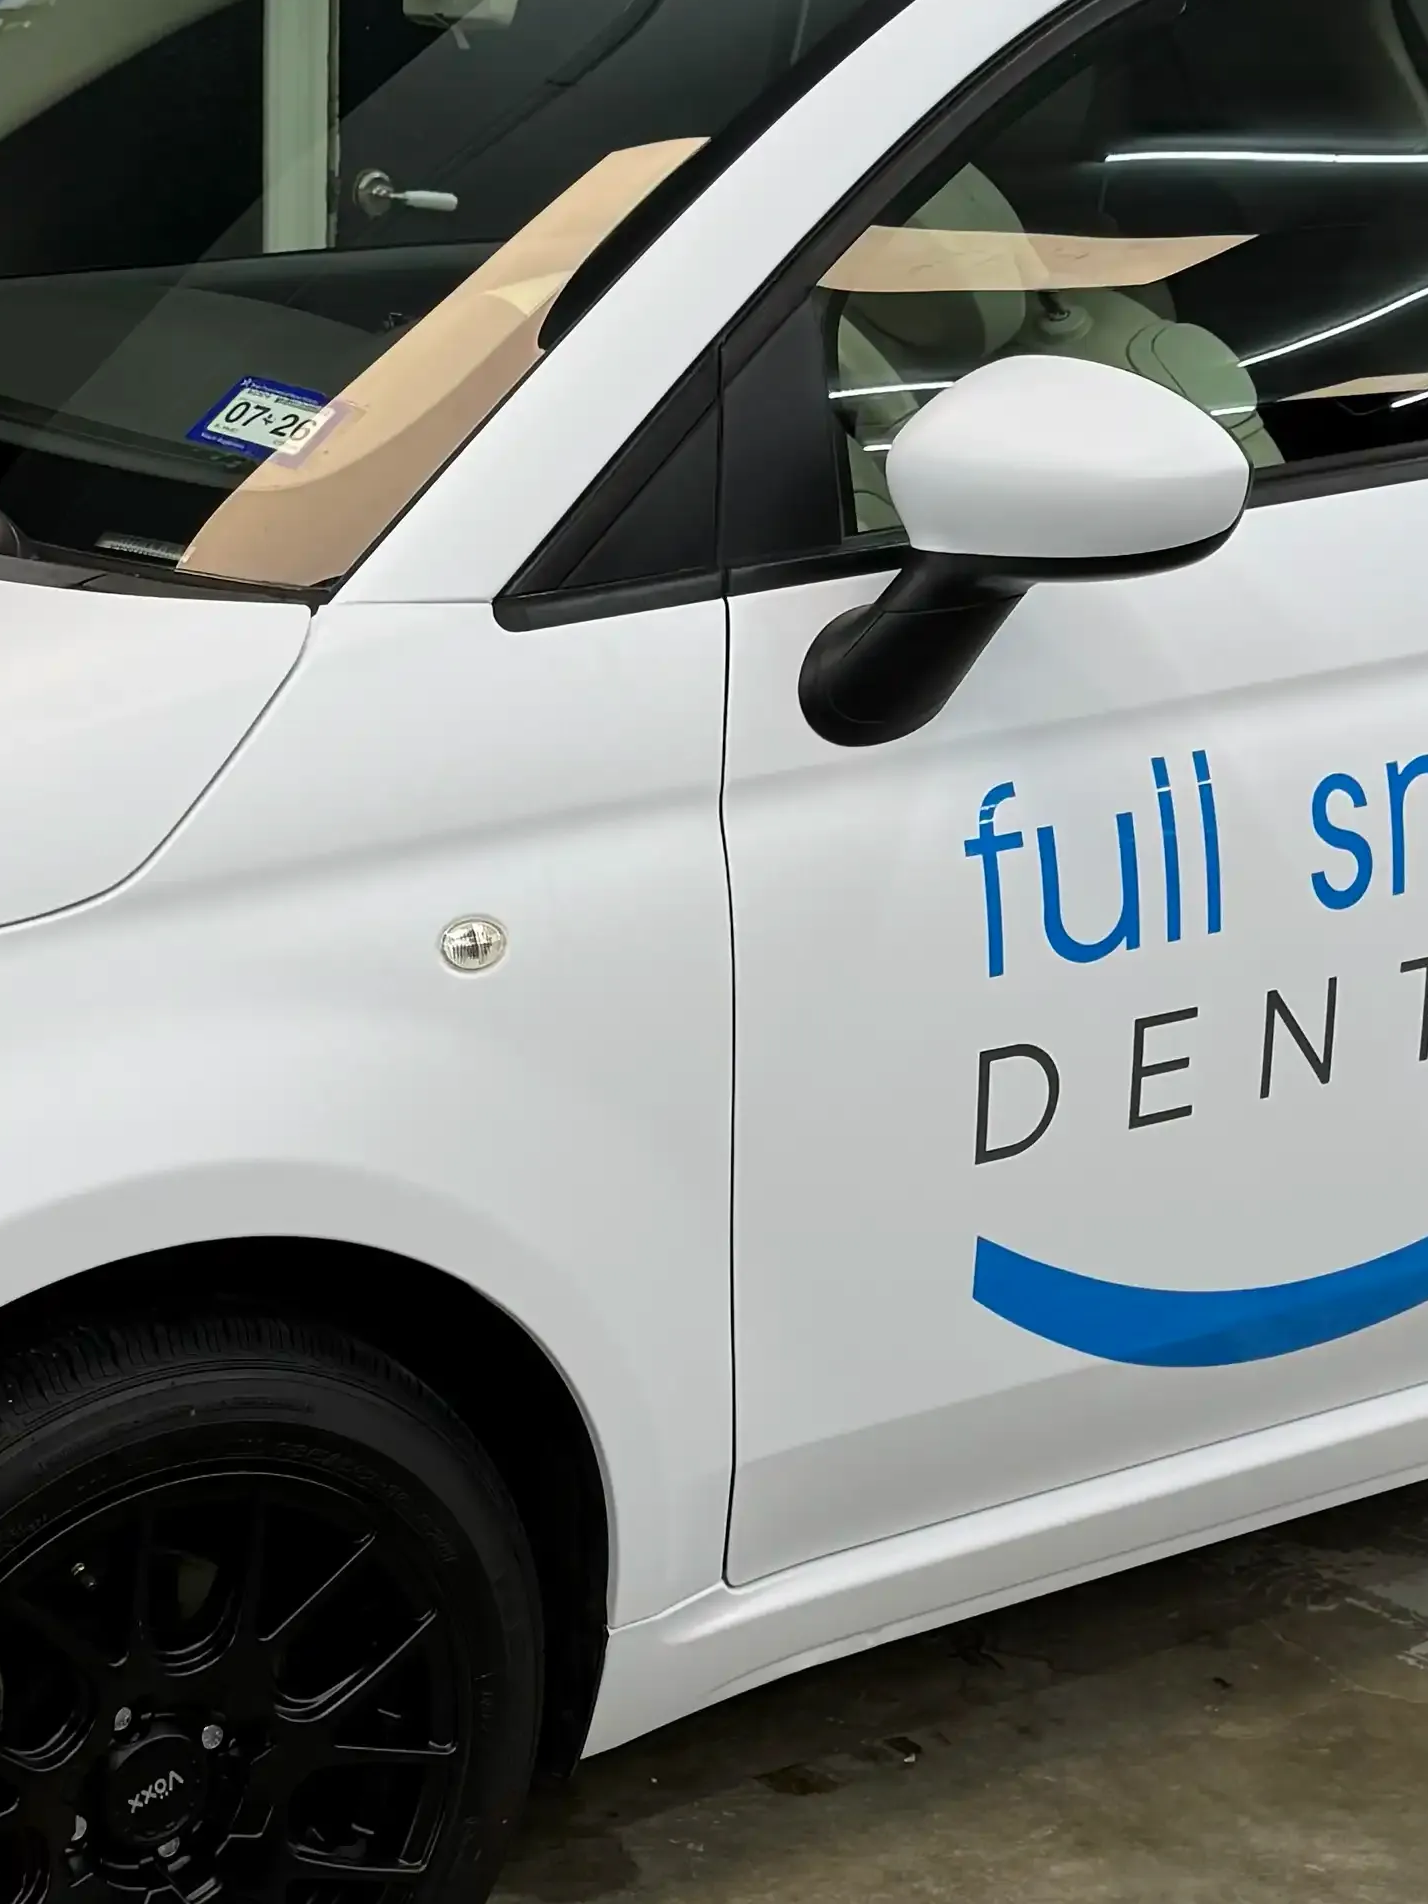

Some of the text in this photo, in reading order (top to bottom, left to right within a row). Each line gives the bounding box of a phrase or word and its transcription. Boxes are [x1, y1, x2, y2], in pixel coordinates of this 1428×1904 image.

[224, 401, 271, 427] 07
[269, 413, 317, 441] 26
[963, 749, 1222, 978] full
